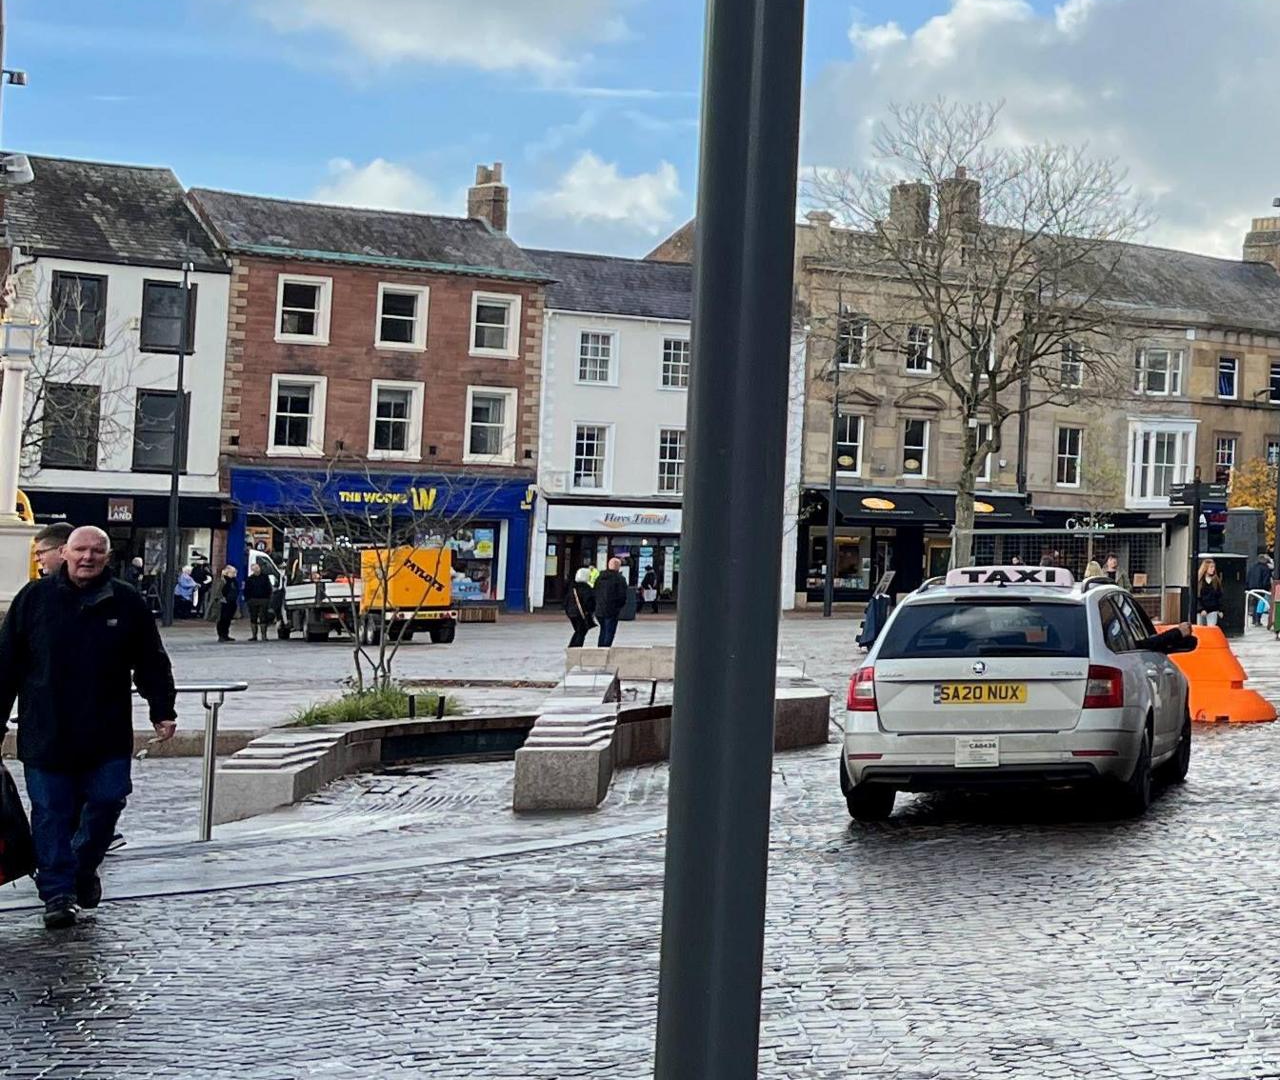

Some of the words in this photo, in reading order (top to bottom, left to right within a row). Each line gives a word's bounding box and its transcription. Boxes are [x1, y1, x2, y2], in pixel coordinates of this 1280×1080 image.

[339, 491, 361, 503] THE
[960, 569, 1057, 584] TAXI
[940, 686, 983, 701] SA20
[987, 685, 1020, 700] NUX
